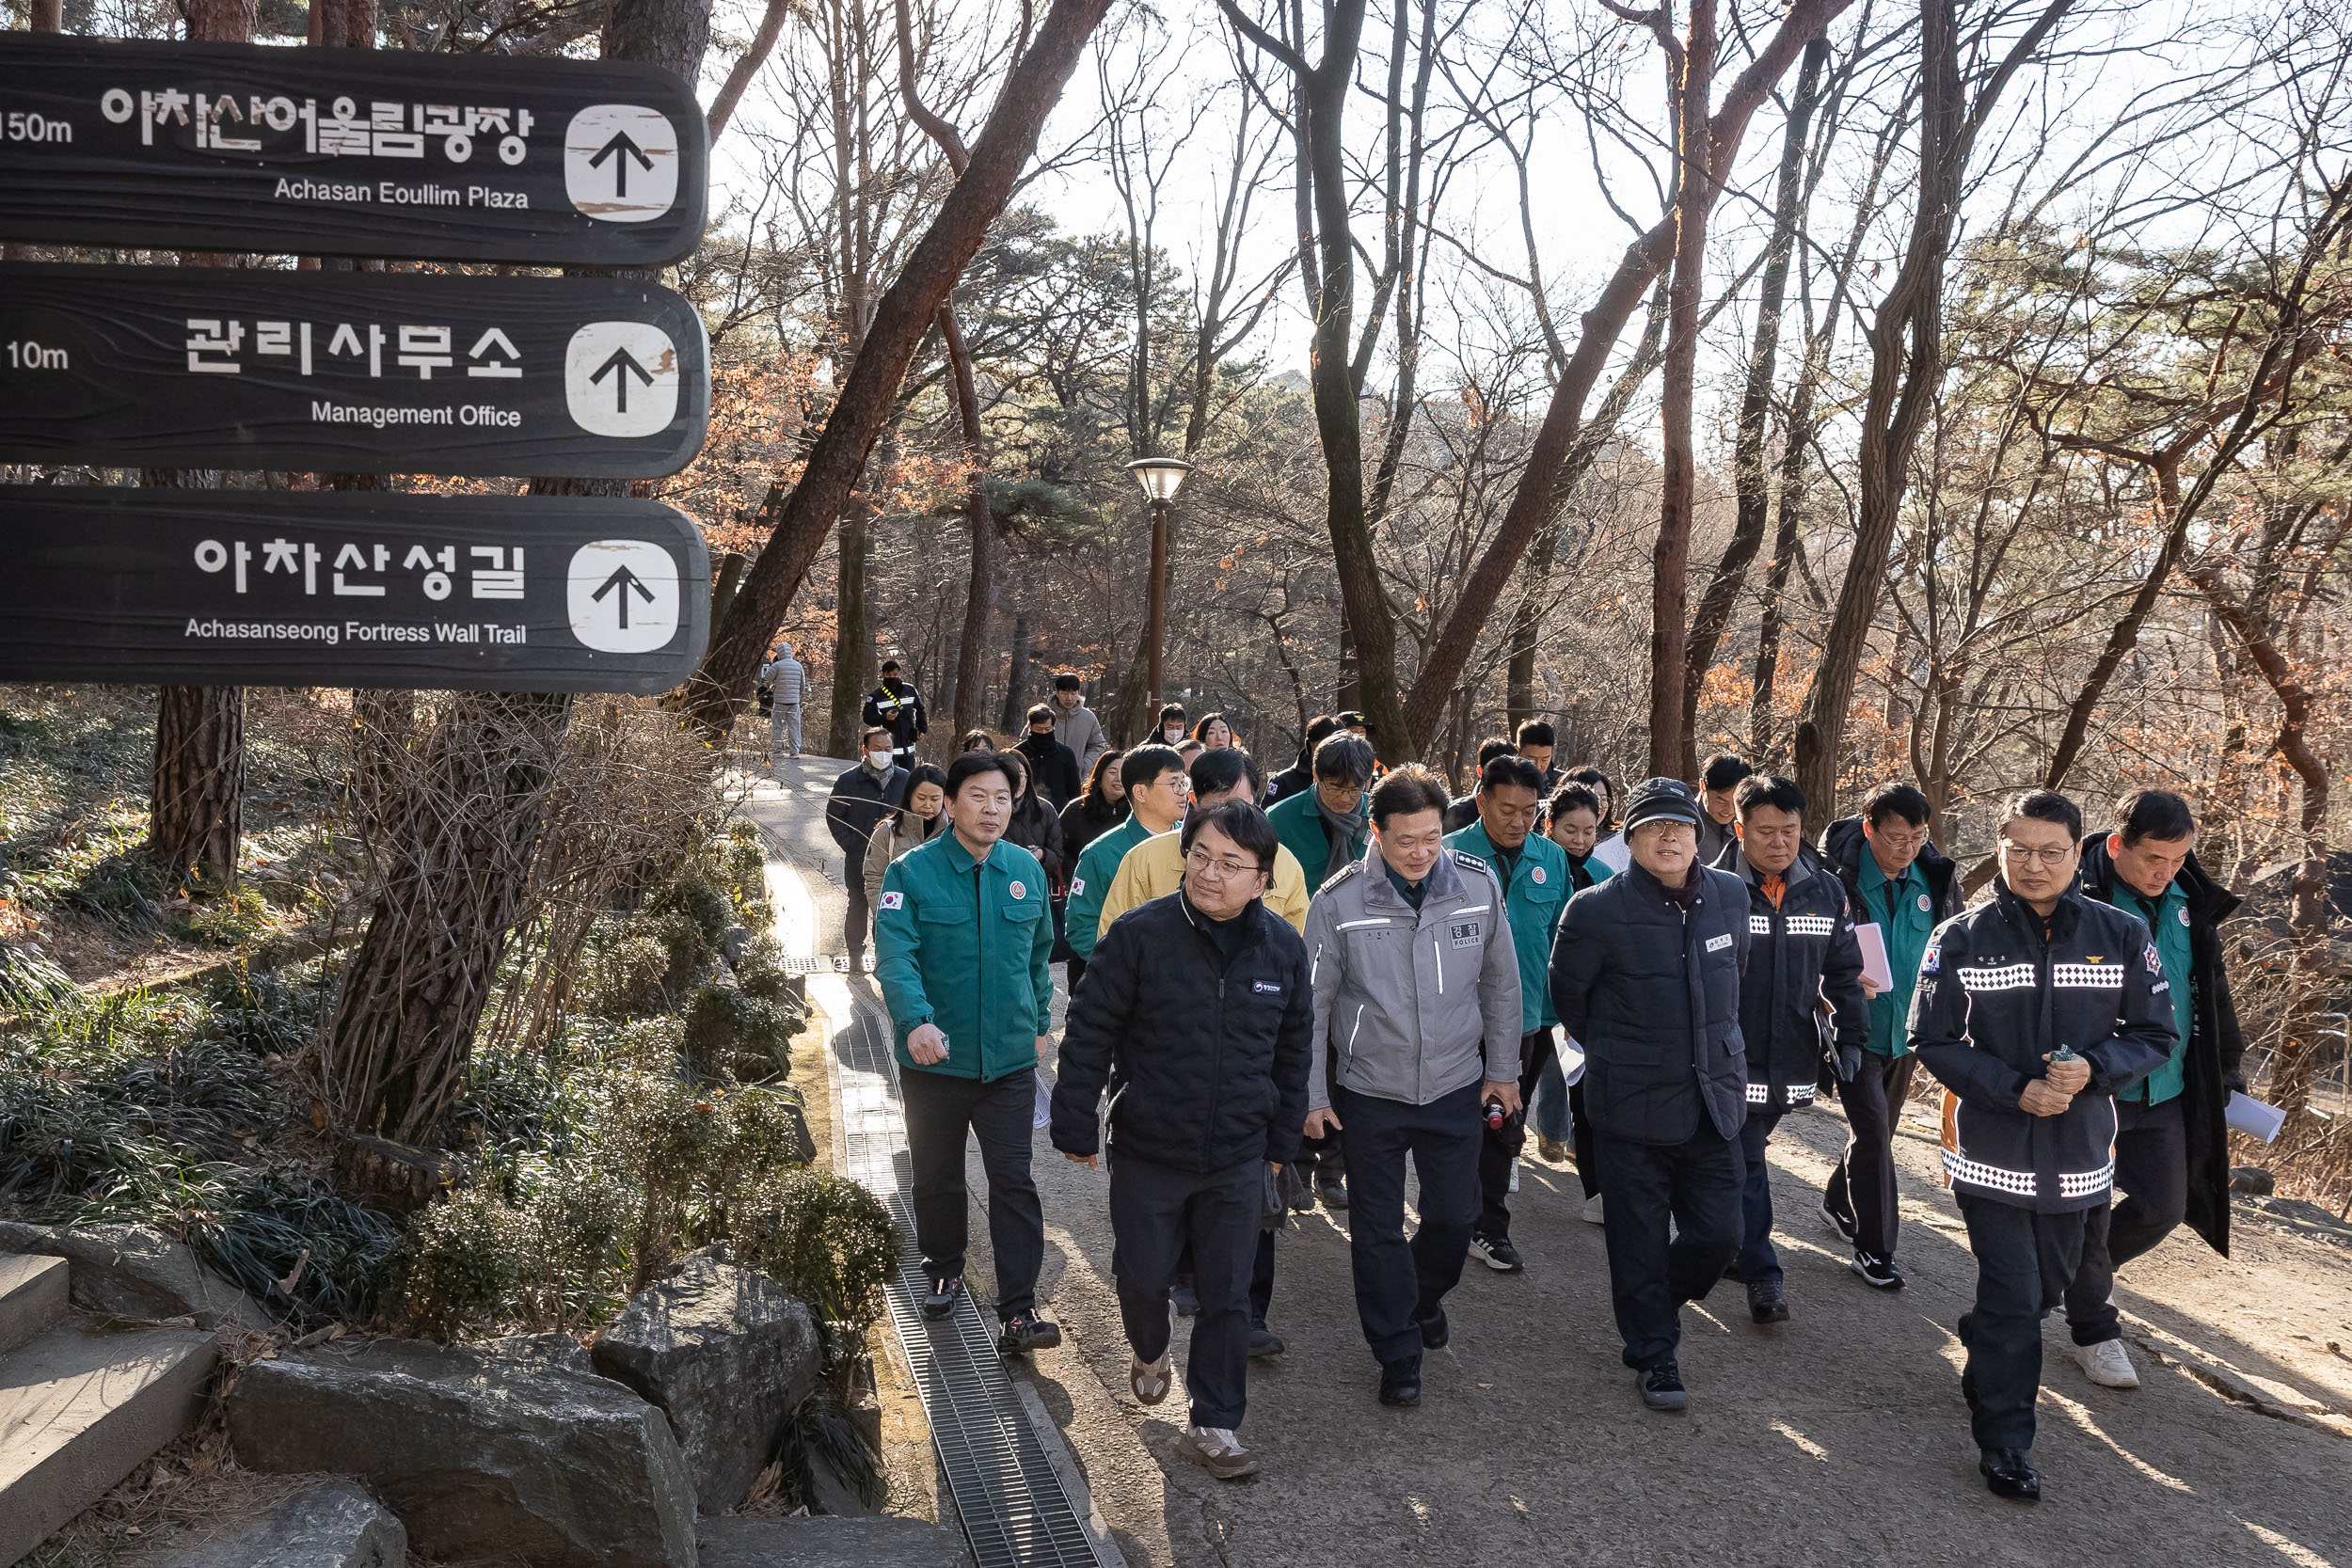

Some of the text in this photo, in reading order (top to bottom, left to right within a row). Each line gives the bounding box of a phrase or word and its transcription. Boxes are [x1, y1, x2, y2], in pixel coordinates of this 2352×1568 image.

[101, 88, 534, 166] 아차산어울림광장
[275, 178, 529, 209] Achasan Eoullim Plaza
[7, 341, 69, 370] 10m
[186, 319, 523, 380] 관리사무소
[311, 401, 521, 429] Management Office
[194, 538, 525, 601] 아차산성길
[184, 618, 527, 645] Achasanseong Fortress Wall Trail
[1453, 924, 1477, 938] 경찰
[1454, 937, 1479, 946] POLICE
